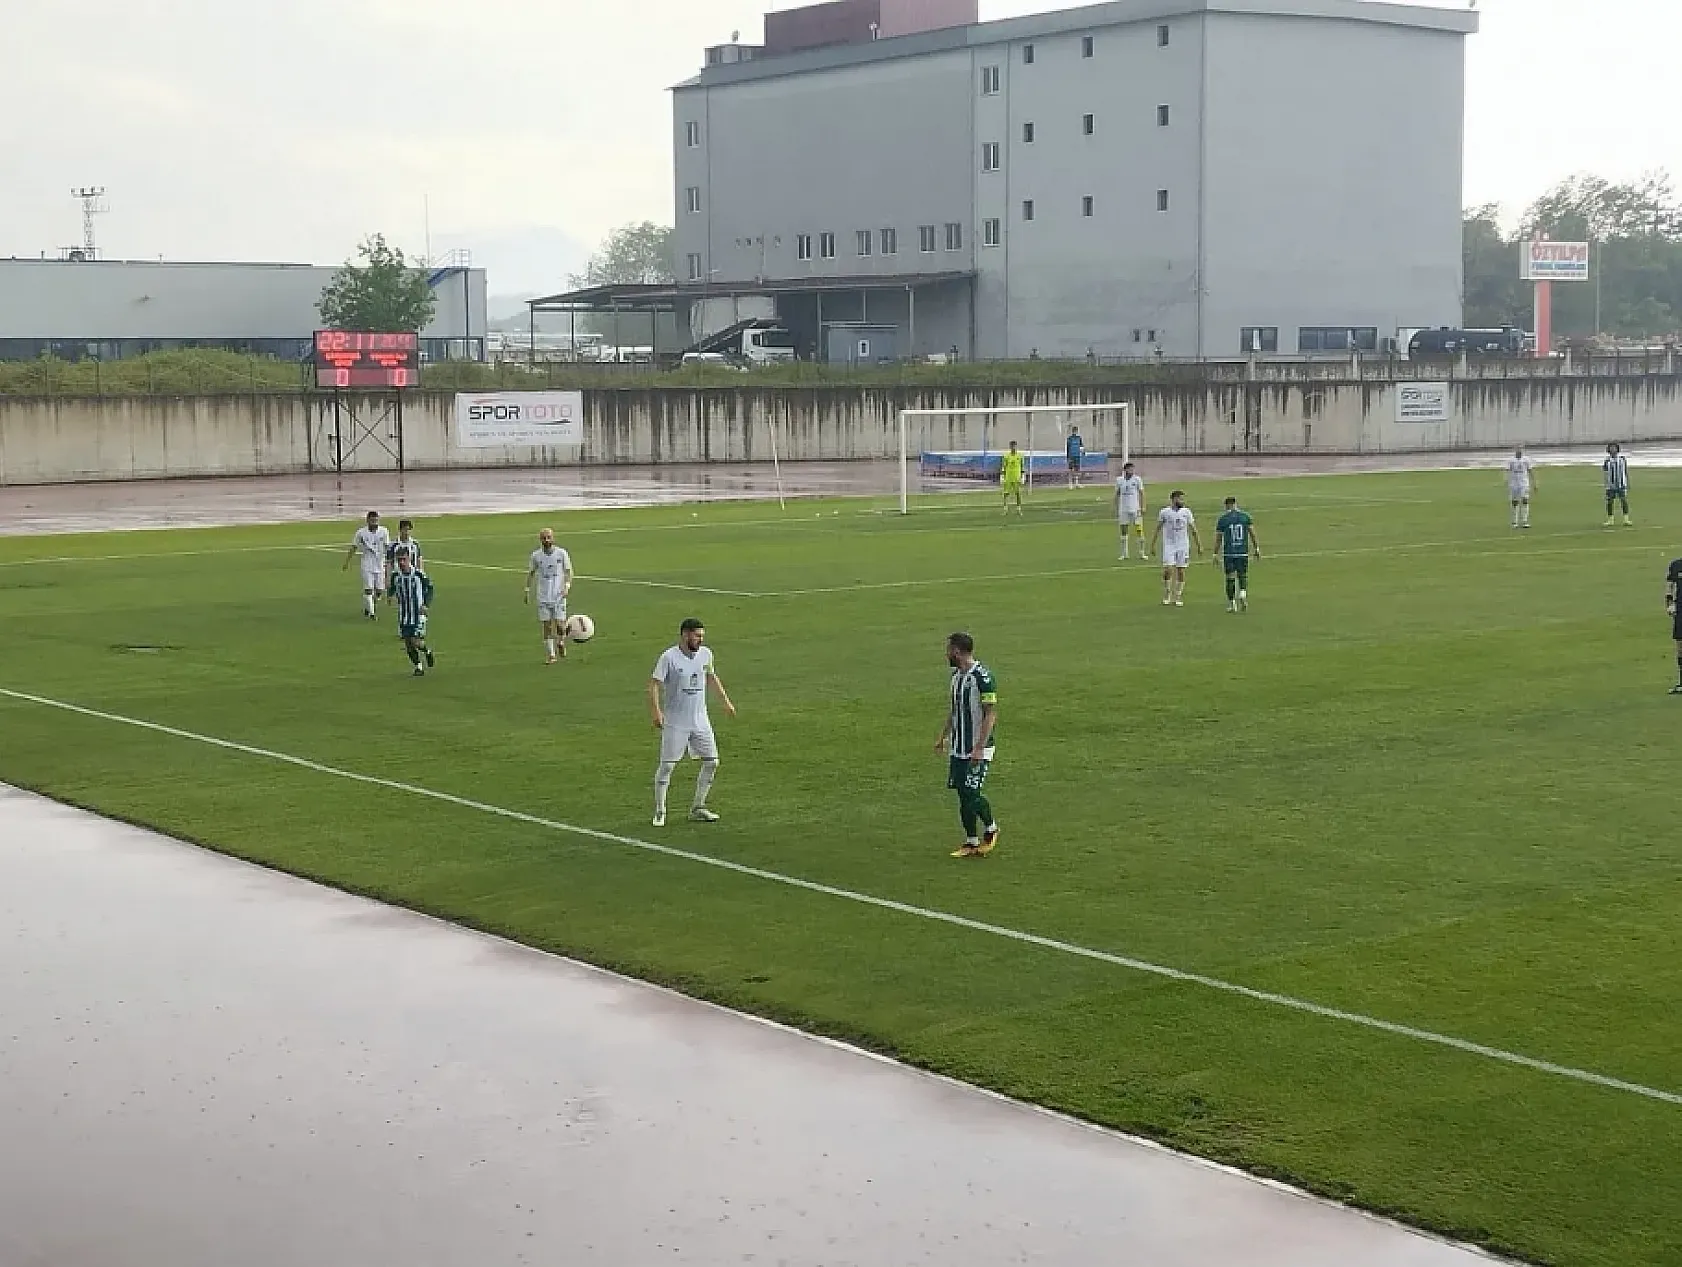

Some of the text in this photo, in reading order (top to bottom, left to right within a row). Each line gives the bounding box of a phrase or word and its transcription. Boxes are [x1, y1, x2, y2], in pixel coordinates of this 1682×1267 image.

[336, 368, 349, 387] 0
[394, 368, 407, 387] 0
[1229, 524, 1243, 541] 10
